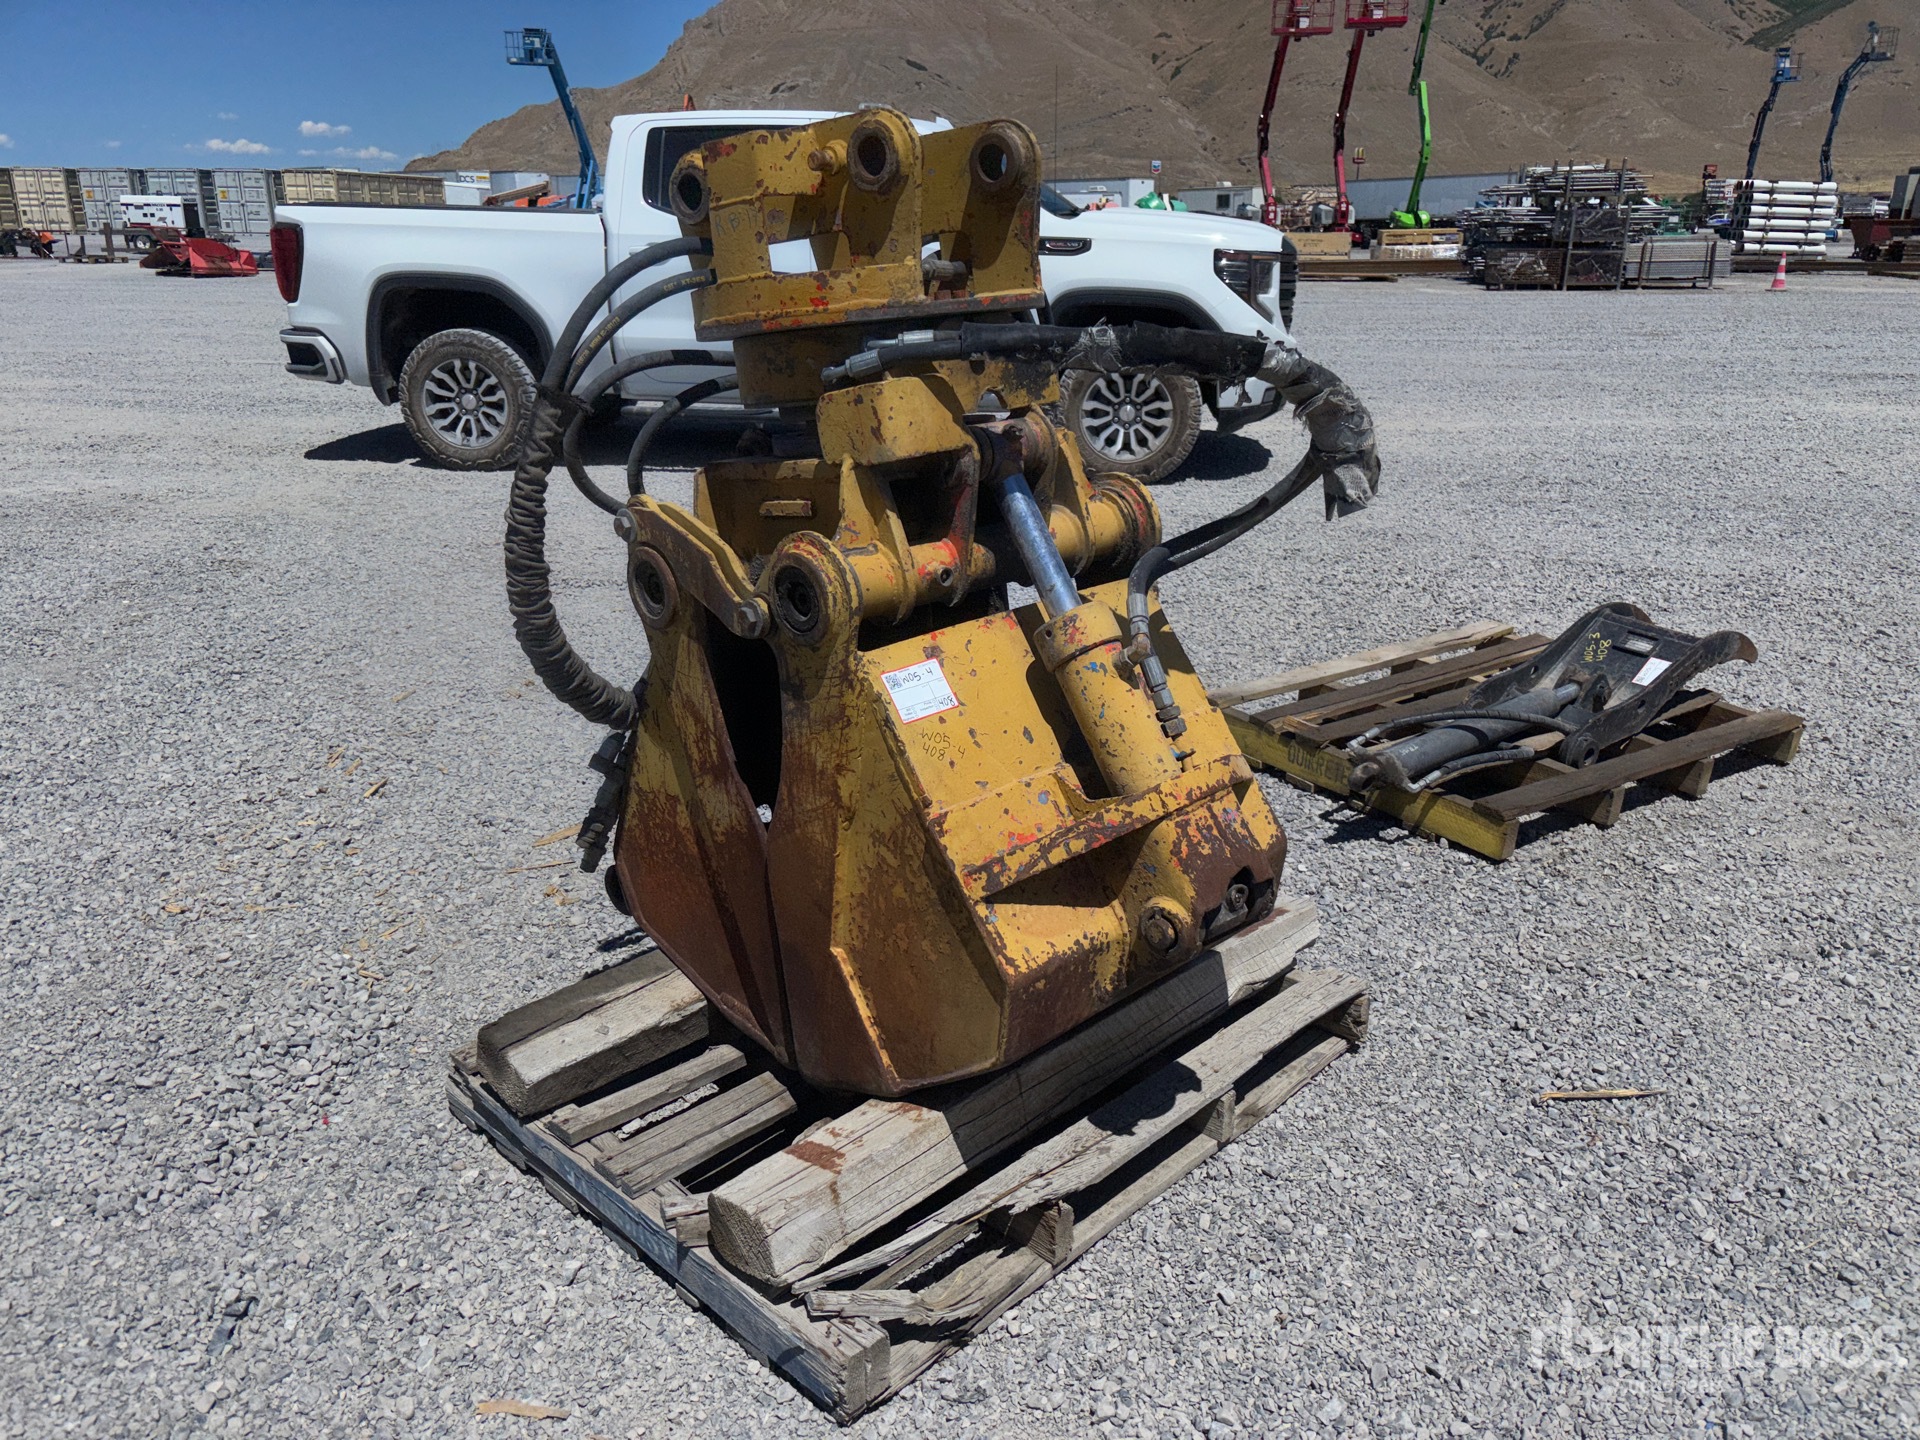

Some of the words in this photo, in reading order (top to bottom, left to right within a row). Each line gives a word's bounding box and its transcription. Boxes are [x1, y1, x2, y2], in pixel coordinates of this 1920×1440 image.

[1596, 639, 1612, 662] 408
[937, 695, 956, 707] 408
[922, 742, 946, 762] 408
